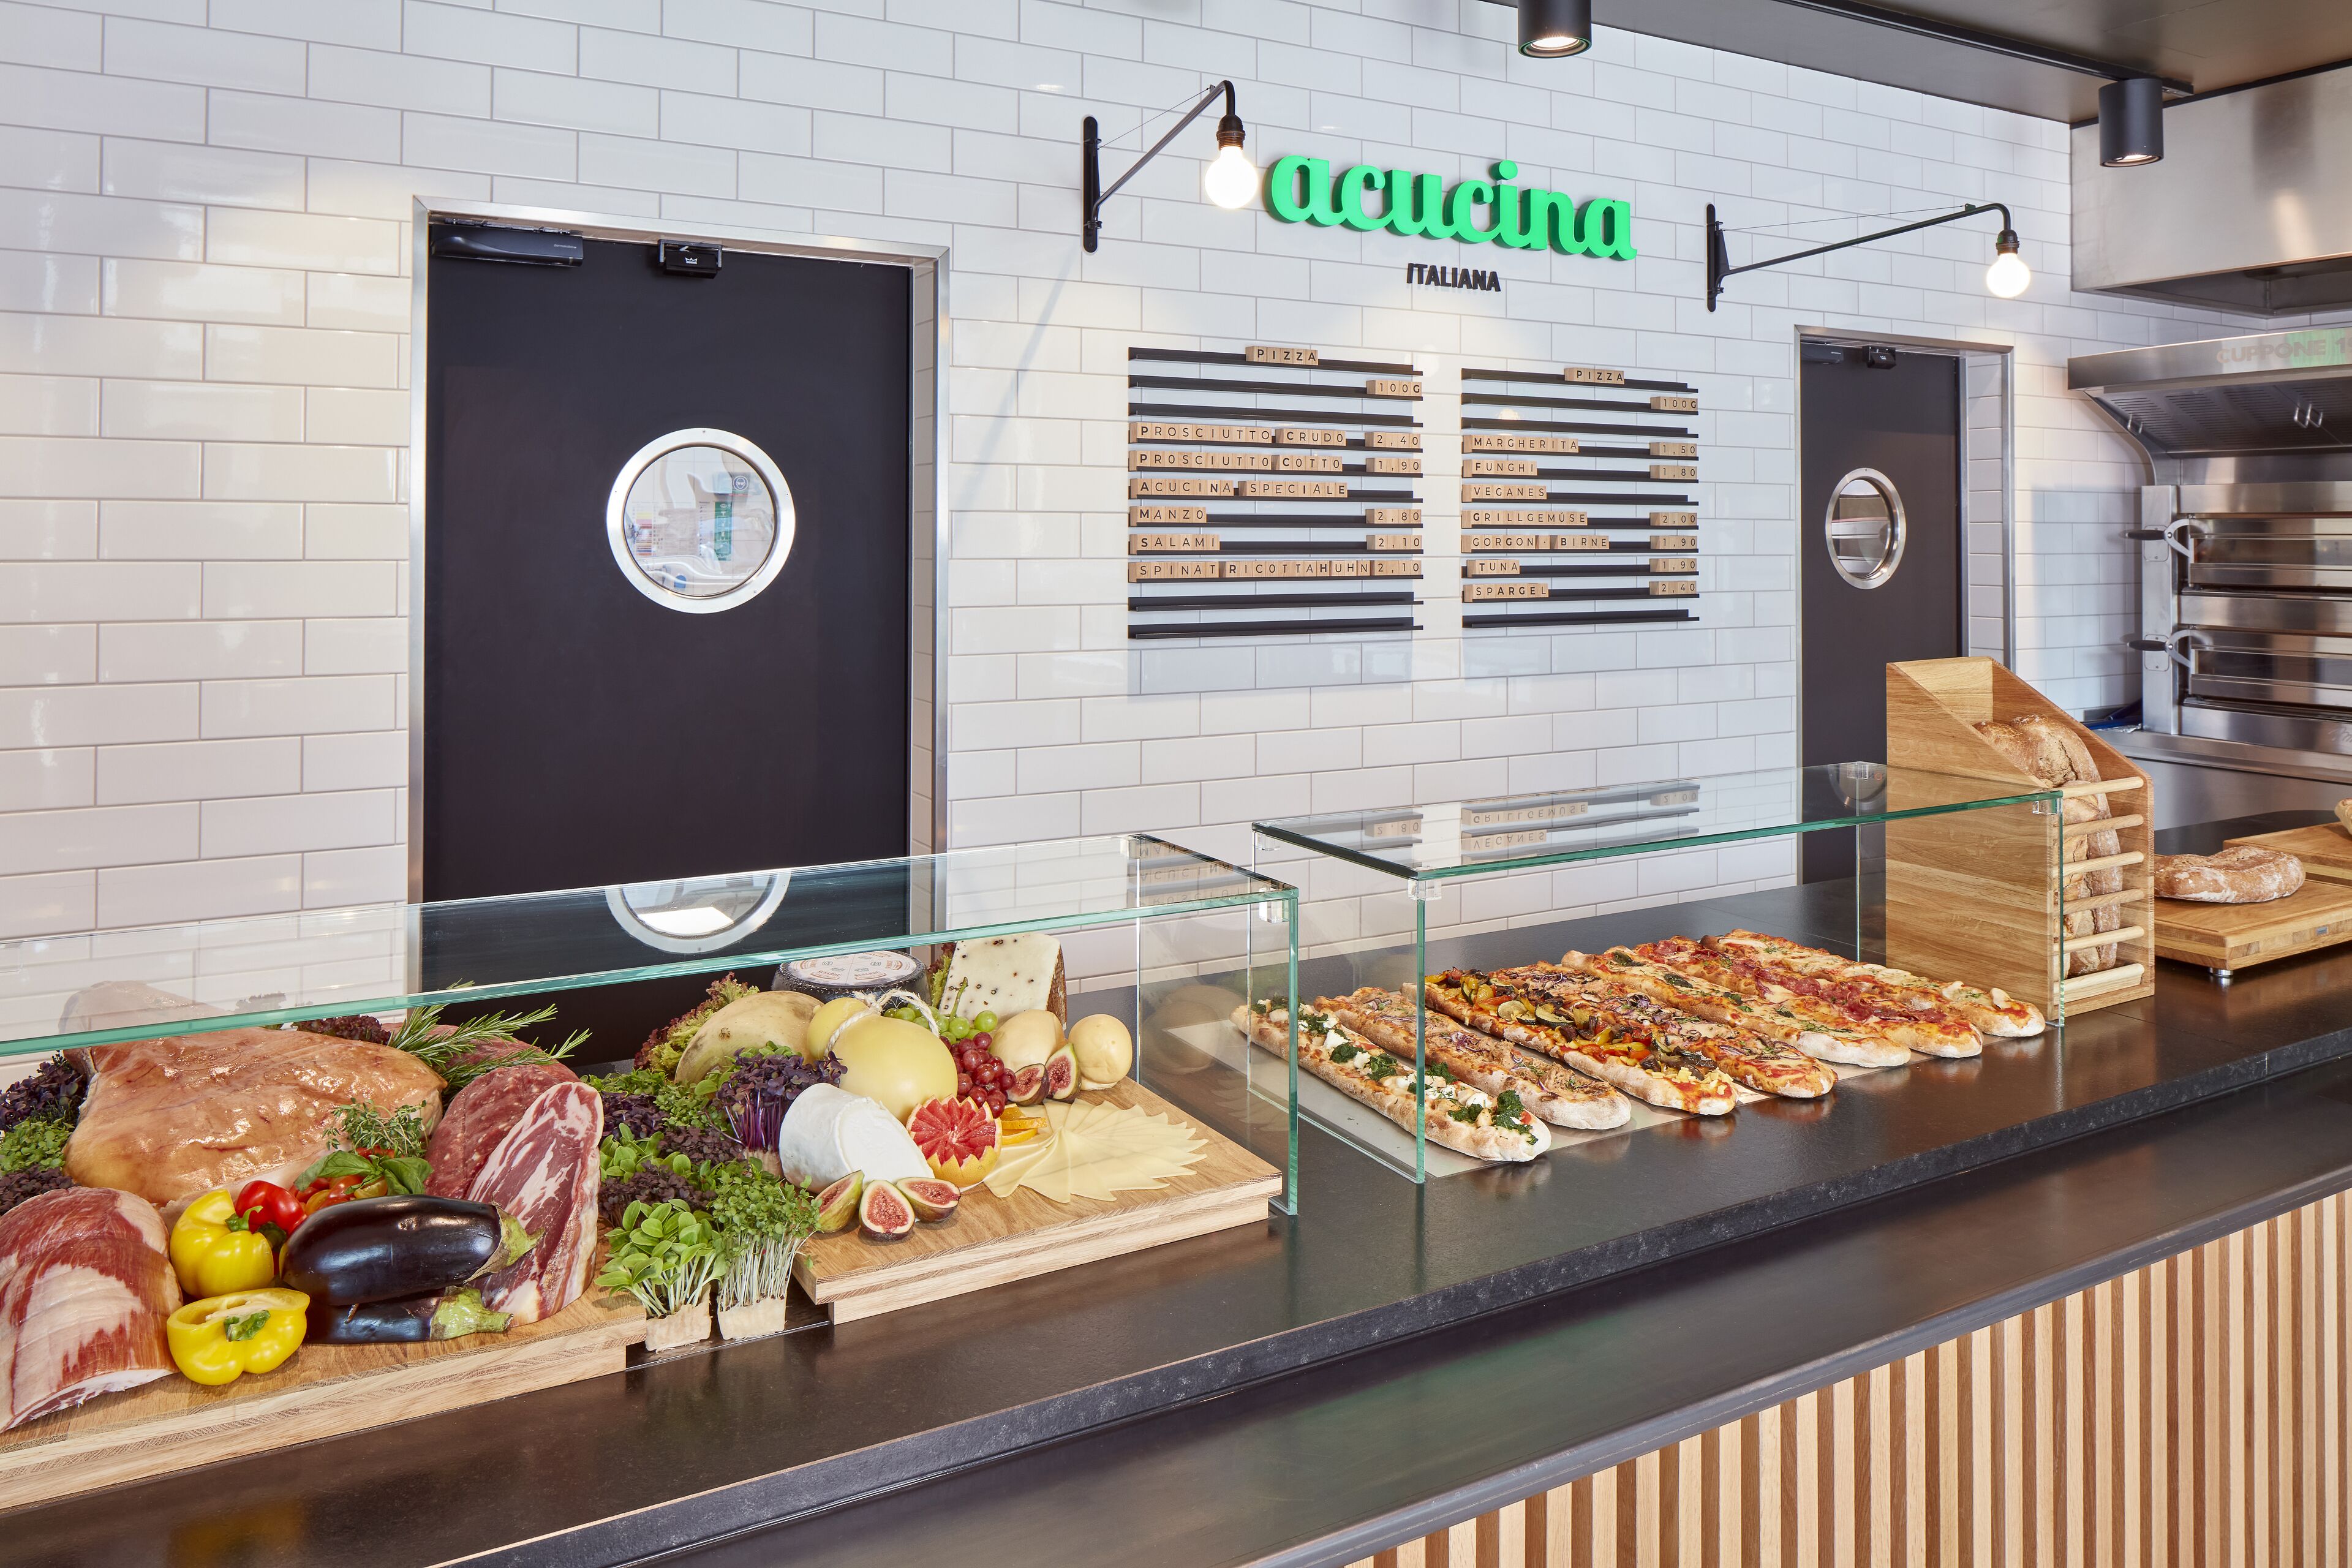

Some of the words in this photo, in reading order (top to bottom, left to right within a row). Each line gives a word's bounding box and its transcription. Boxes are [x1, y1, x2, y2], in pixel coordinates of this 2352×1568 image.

[1264, 155, 1638, 260] acucina
[1406, 263, 1501, 292] ITALIANA
[1257, 349, 1316, 362] PIZZA
[2216, 339, 2326, 363] CUPPONE
[1577, 371, 1623, 381] PIZZA
[1379, 382, 1420, 394] 100G
[1664, 399, 1697, 409] 100G
[1140, 426, 1270, 440] PROSCIUTTO
[1286, 431, 1343, 443] CRUDO
[1377, 434, 1419, 447] 2,40
[1474, 437, 1577, 450] MARGHERITA
[1662, 445, 1695, 455] 1,50
[1140, 453, 1269, 467] PROSCIUTTO
[1283, 457, 1340, 469] COTTO
[1378, 461, 1419, 471] 1,90
[1476, 462, 1534, 472] FUNGHI
[1663, 467, 1695, 478] 1,80
[1140, 481, 1231, 493] ACUCINA
[1250, 483, 1345, 496] SPECIALE
[1474, 487, 1545, 497] VEGANES
[1139, 508, 1204, 520] MANZO
[1378, 511, 1419, 522] 2,80
[1662, 515, 1695, 524] 2,00
[1140, 537, 1215, 548] SALAMI
[1378, 537, 1420, 548] 2,10
[1472, 538, 1534, 547] GORGON
[1560, 537, 1607, 547] BIRNE
[1662, 538, 1696, 548] 1,90
[1378, 562, 1419, 573] 2,10
[1479, 562, 1518, 571] TUNA
[1662, 560, 1695, 570] 1,90
[1476, 586, 1547, 596] SPARGEL
[1661, 583, 1695, 594] 2,40
